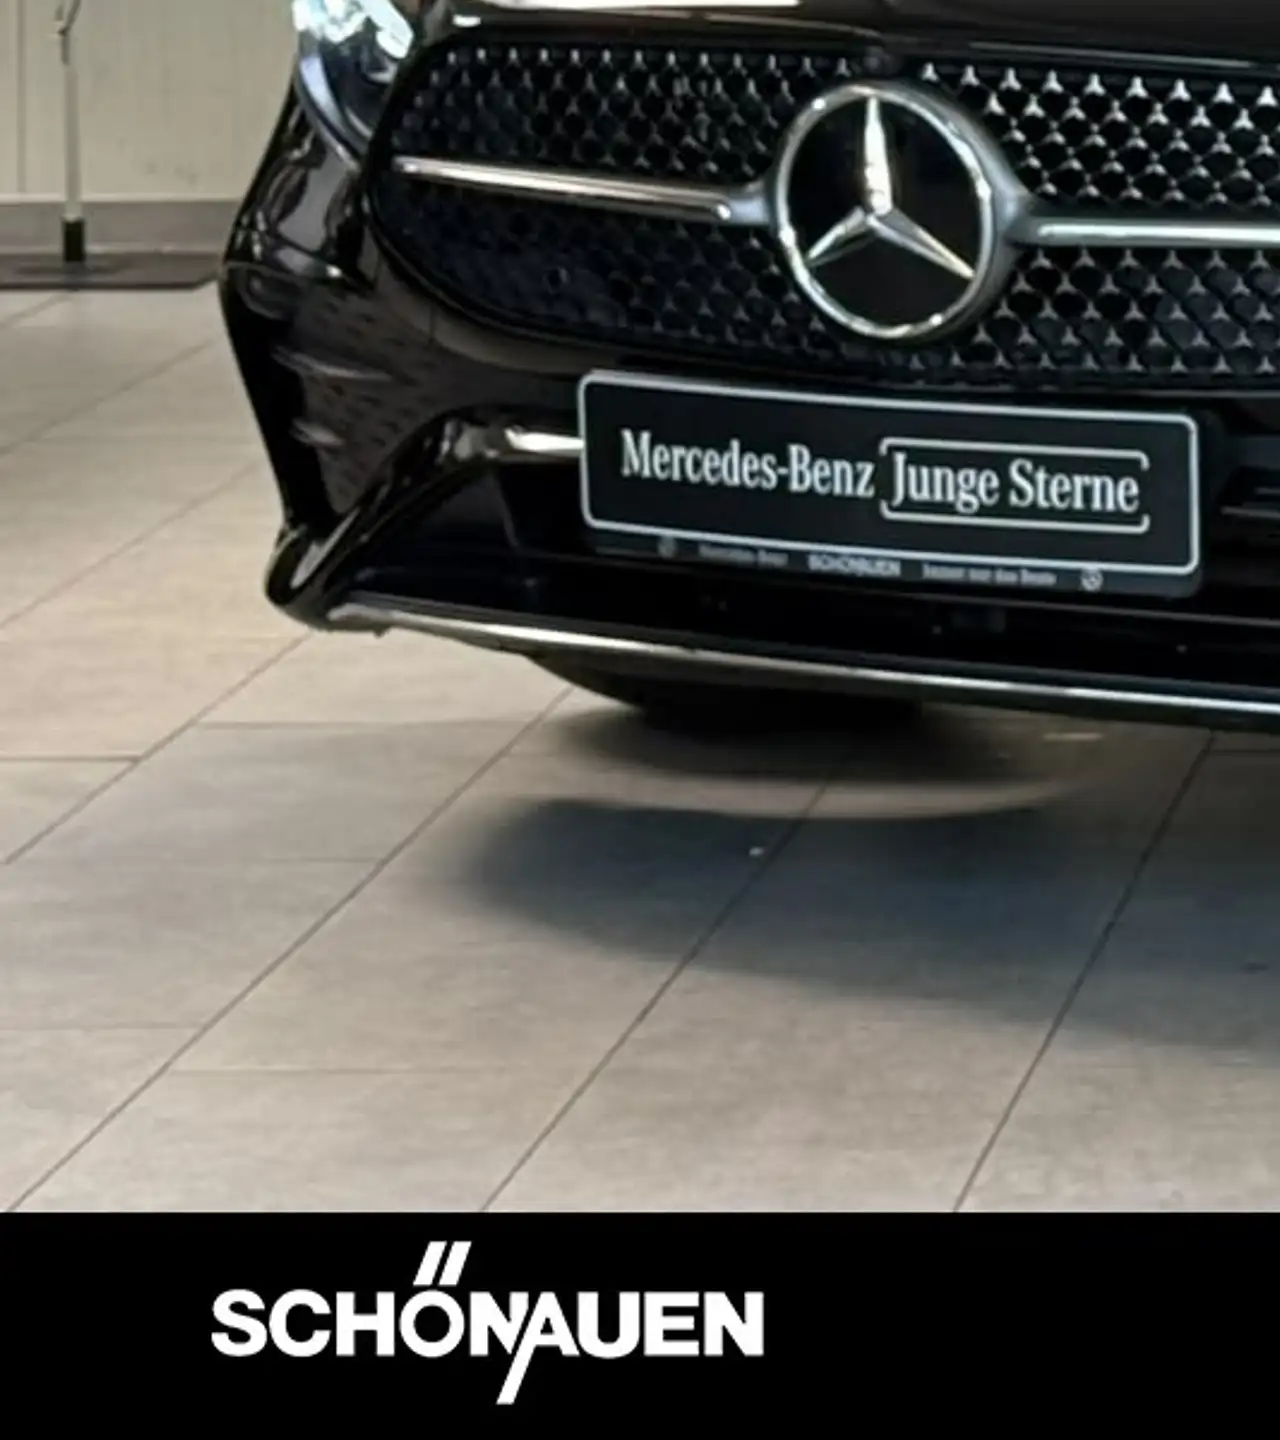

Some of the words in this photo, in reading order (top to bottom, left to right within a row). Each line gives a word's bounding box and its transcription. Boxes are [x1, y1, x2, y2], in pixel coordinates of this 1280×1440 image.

[621, 428, 876, 498] Mercedes-Benz
[890, 451, 1000, 514] Junge
[1008, 457, 1140, 514] Sterne
